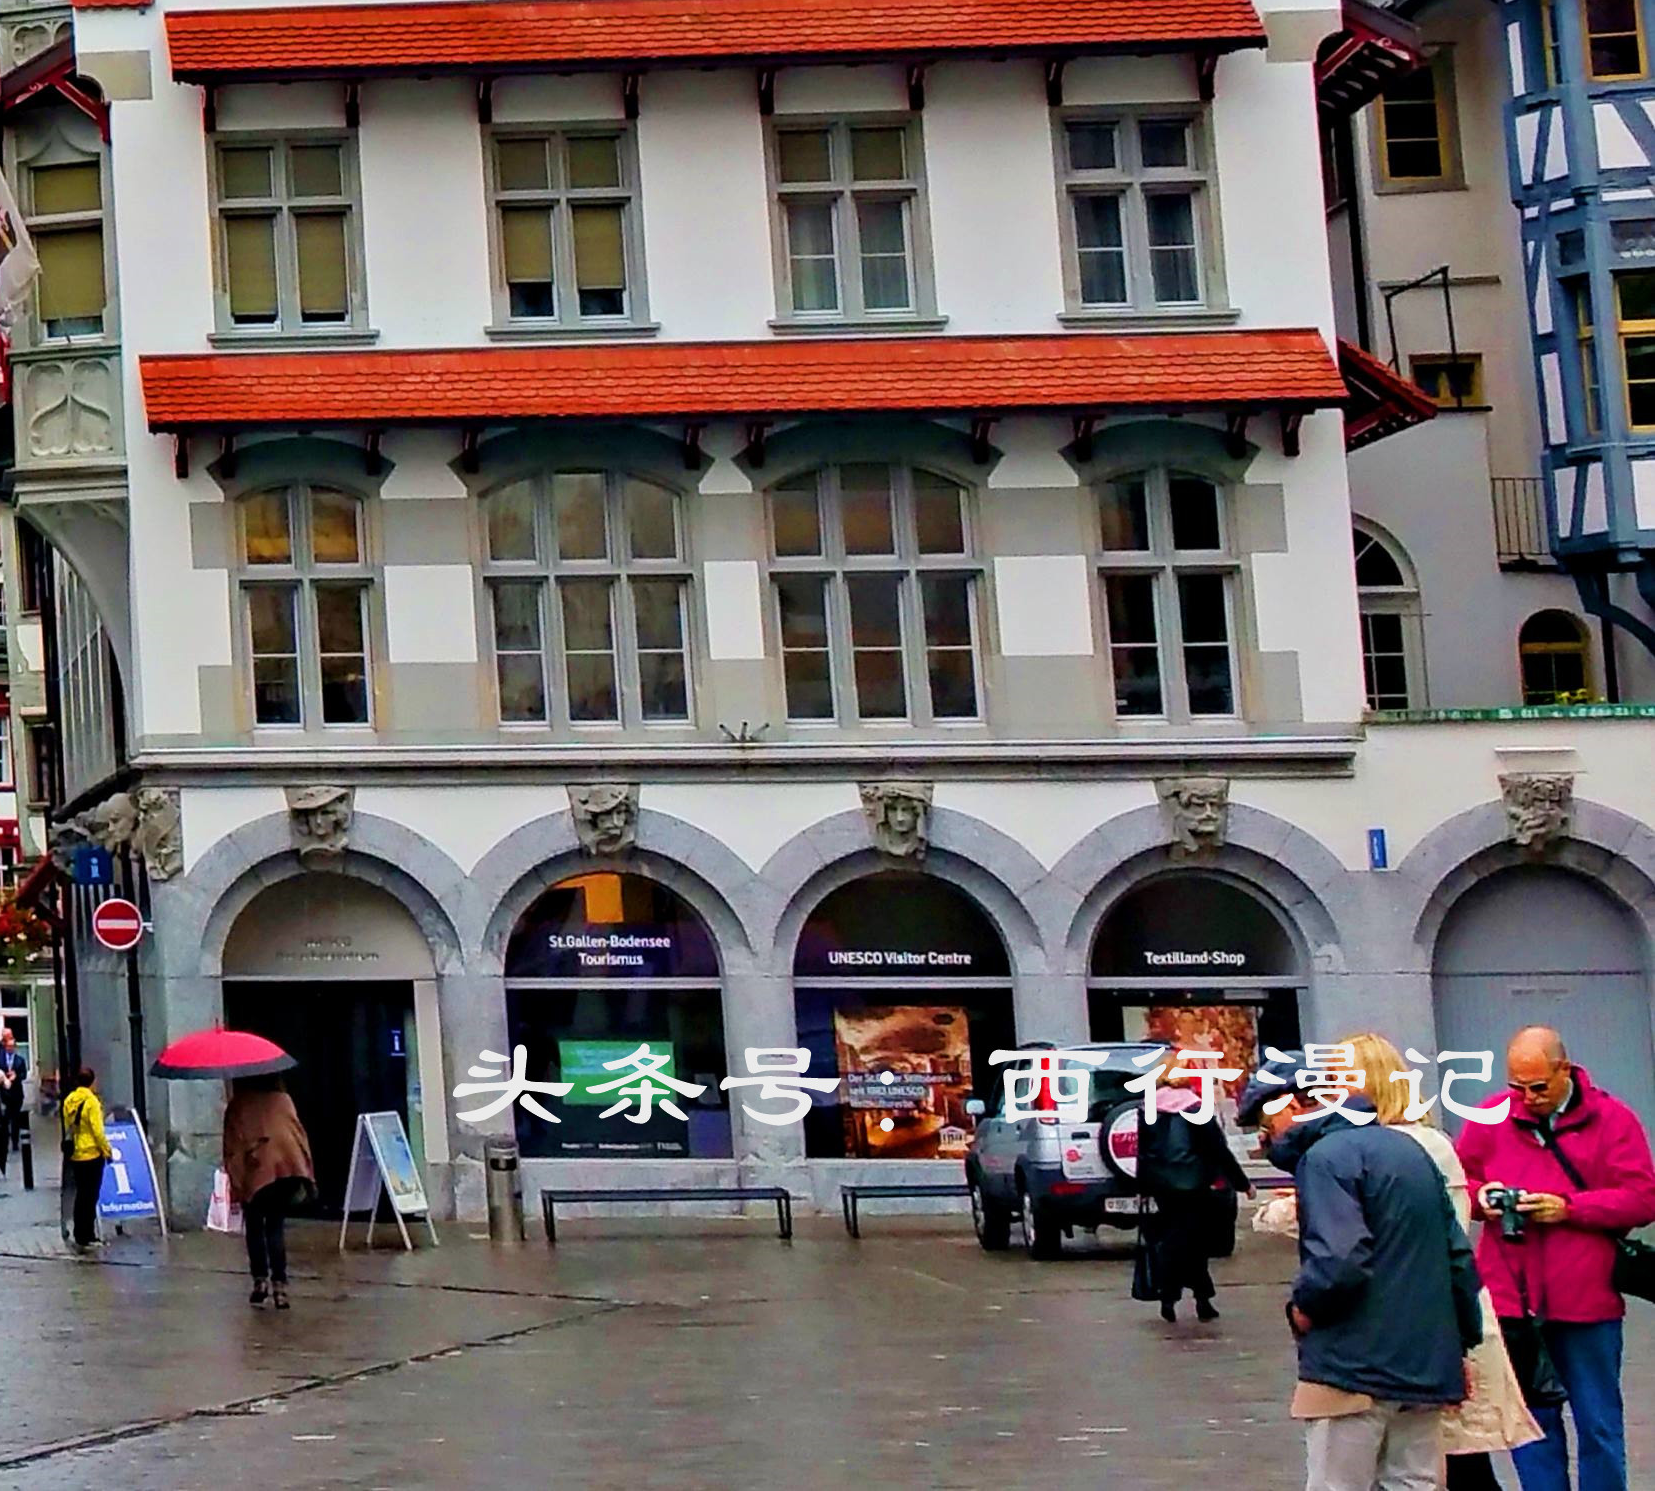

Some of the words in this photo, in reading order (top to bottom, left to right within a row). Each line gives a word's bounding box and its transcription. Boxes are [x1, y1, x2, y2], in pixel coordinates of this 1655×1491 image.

[548, 935, 671, 949] St.Gallen-Bodensee
[578, 952, 644, 965] Tourismus
[827, 951, 882, 965] UNESCO
[884, 951, 926, 965] Visitor
[927, 951, 972, 965] Centre
